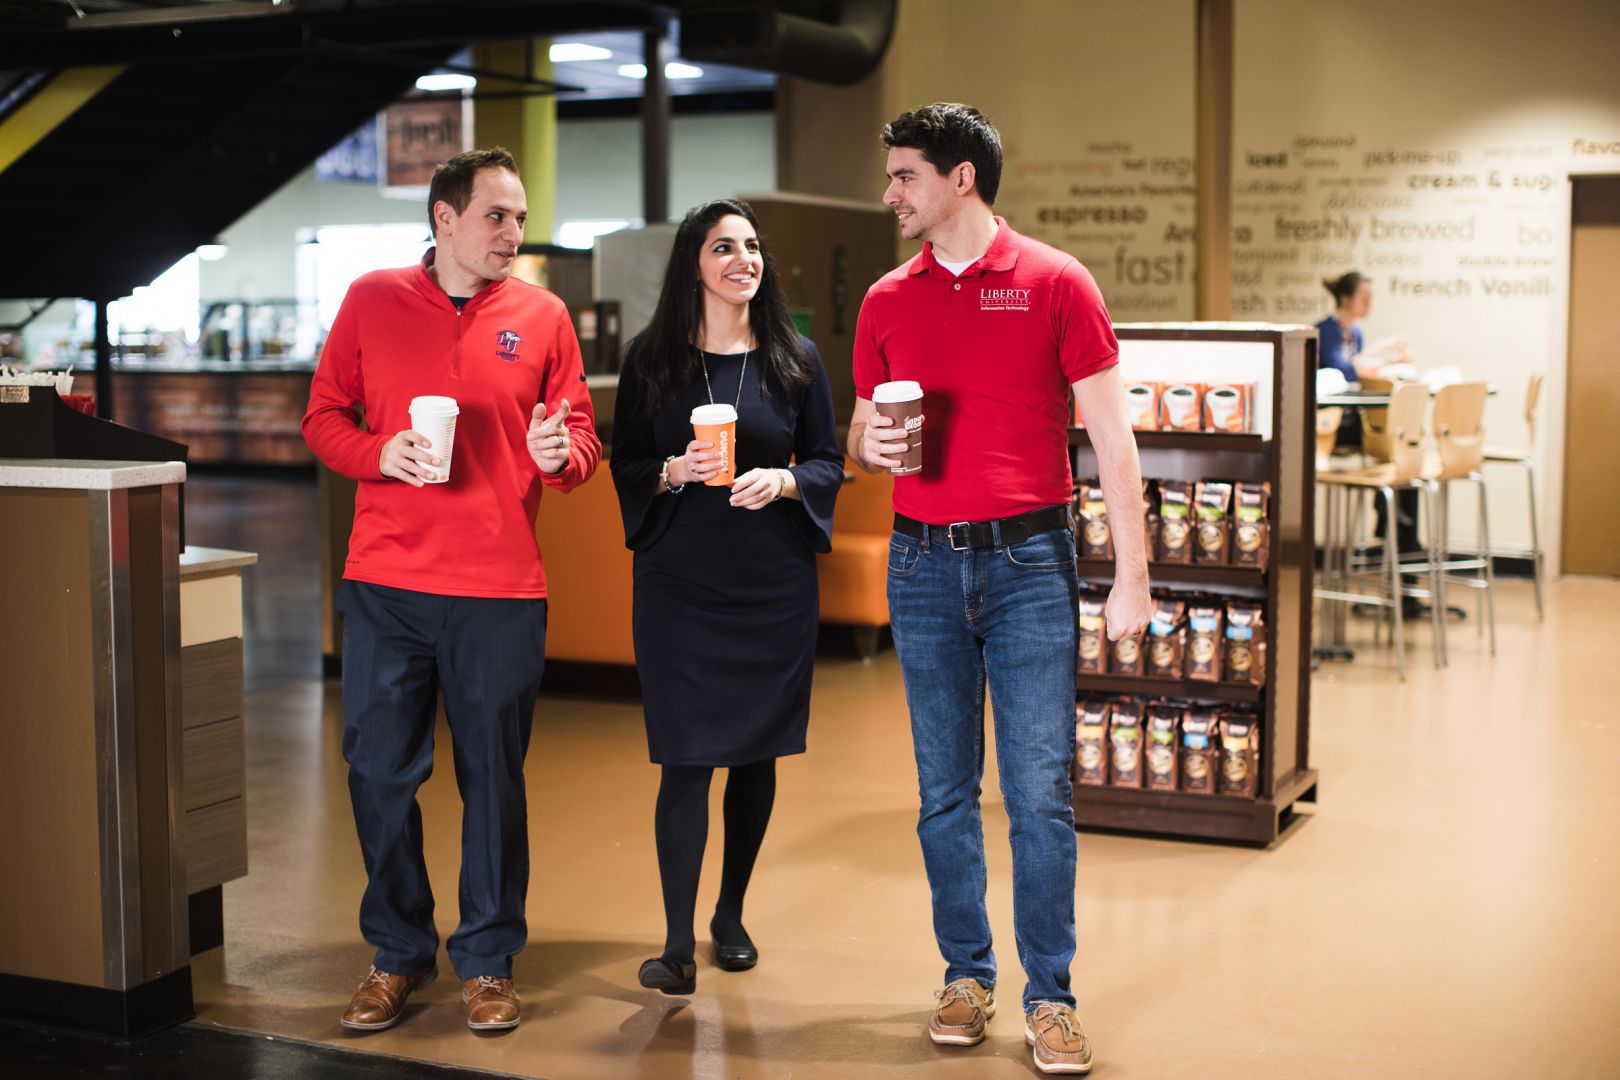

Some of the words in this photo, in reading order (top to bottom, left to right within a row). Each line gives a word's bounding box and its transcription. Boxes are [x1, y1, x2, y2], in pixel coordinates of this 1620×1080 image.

[1407, 174, 1479, 190] cream
[1488, 170, 1503, 188] &
[1037, 206, 1147, 227] espresso
[1275, 216, 1362, 247] freshly
[1371, 216, 1475, 240] brewed
[1115, 244, 1186, 287] fast
[980, 288, 1031, 299] LIBERTY
[1389, 275, 1471, 296] French
